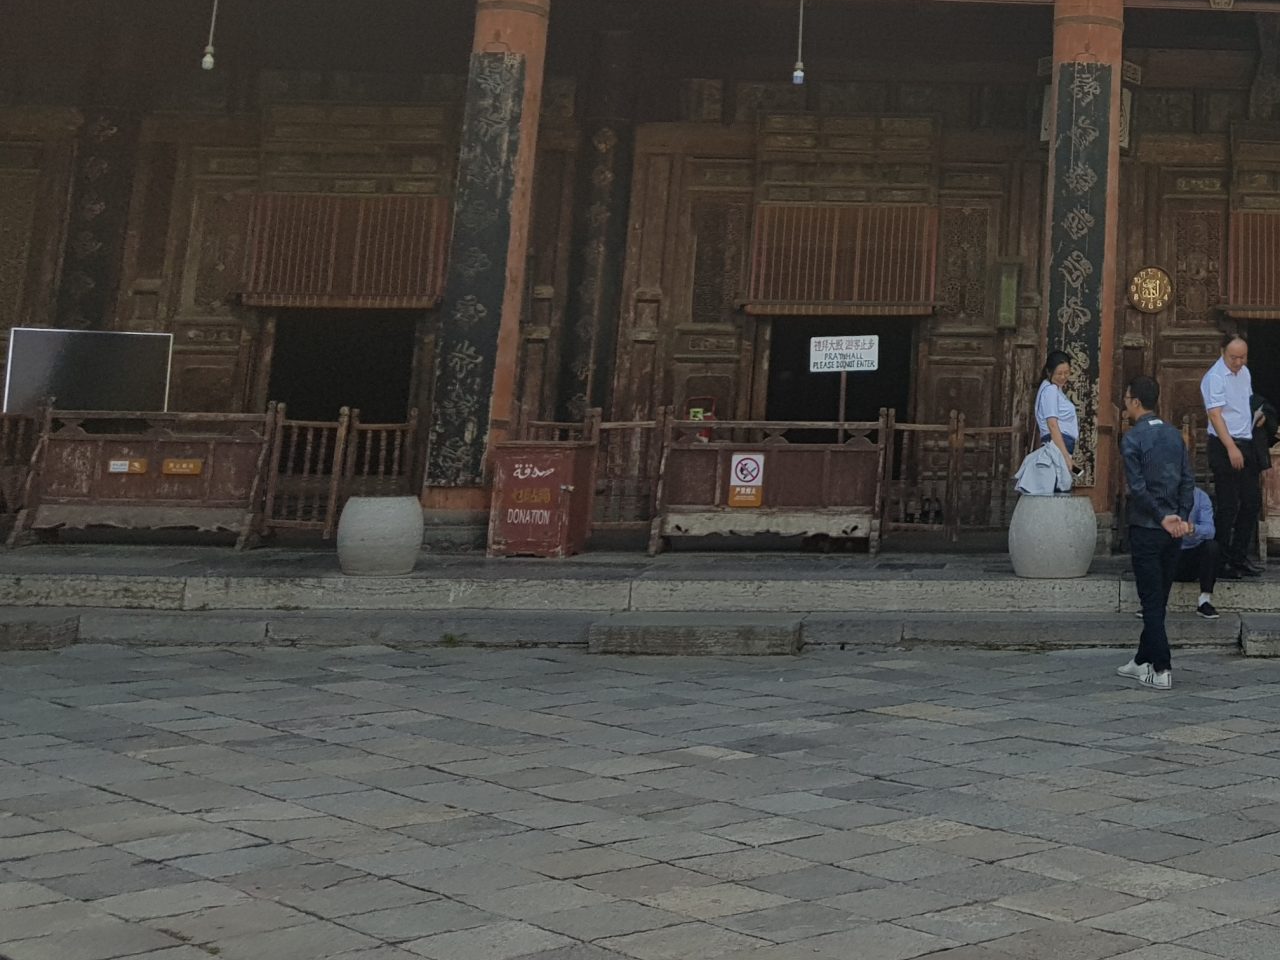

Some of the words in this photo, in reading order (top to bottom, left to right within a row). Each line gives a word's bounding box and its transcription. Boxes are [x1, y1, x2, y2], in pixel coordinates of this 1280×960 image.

[813, 361, 835, 369] PLEASE
[857, 360, 876, 368] ENTER
[513, 464, 555, 479] صدقة
[507, 508, 550, 525] DONATION
